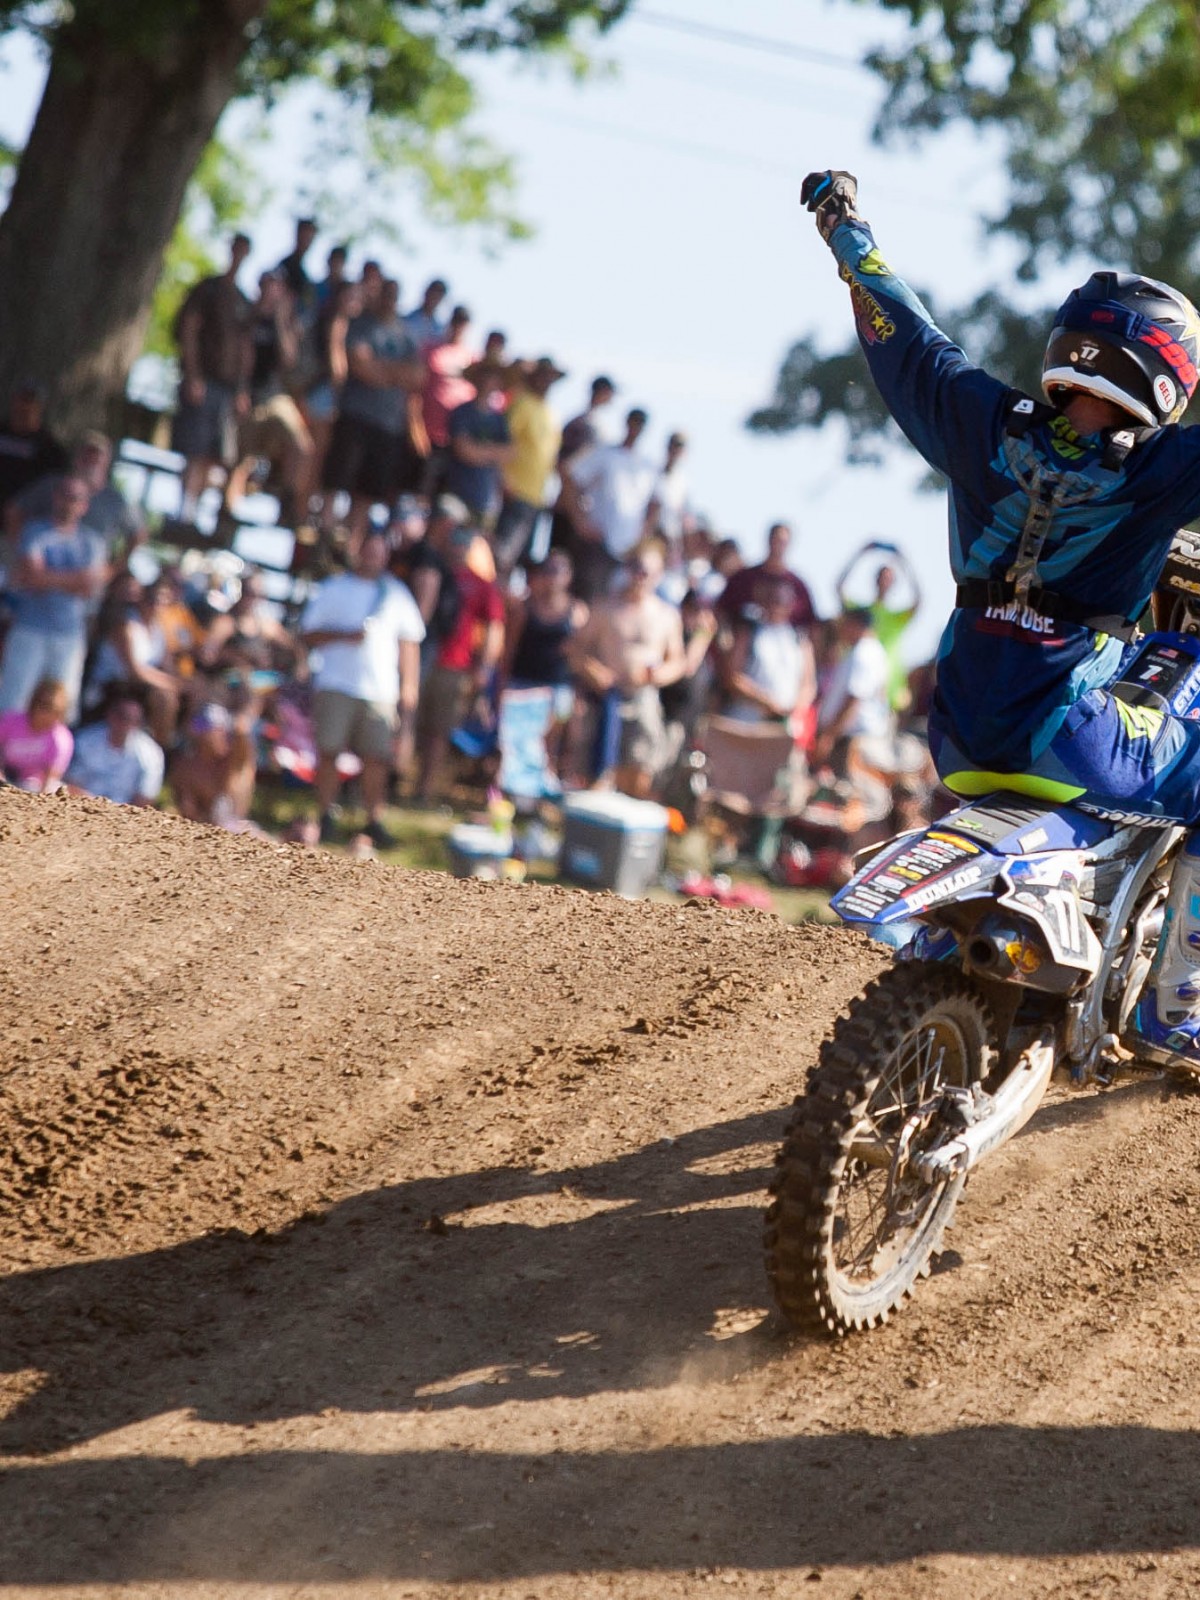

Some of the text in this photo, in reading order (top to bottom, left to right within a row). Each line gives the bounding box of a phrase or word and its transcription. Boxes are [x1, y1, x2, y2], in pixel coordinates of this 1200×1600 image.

[1080, 346, 1100, 361] 17
[1158, 381, 1172, 407] BELL
[904, 866, 981, 913] DUNLOP
